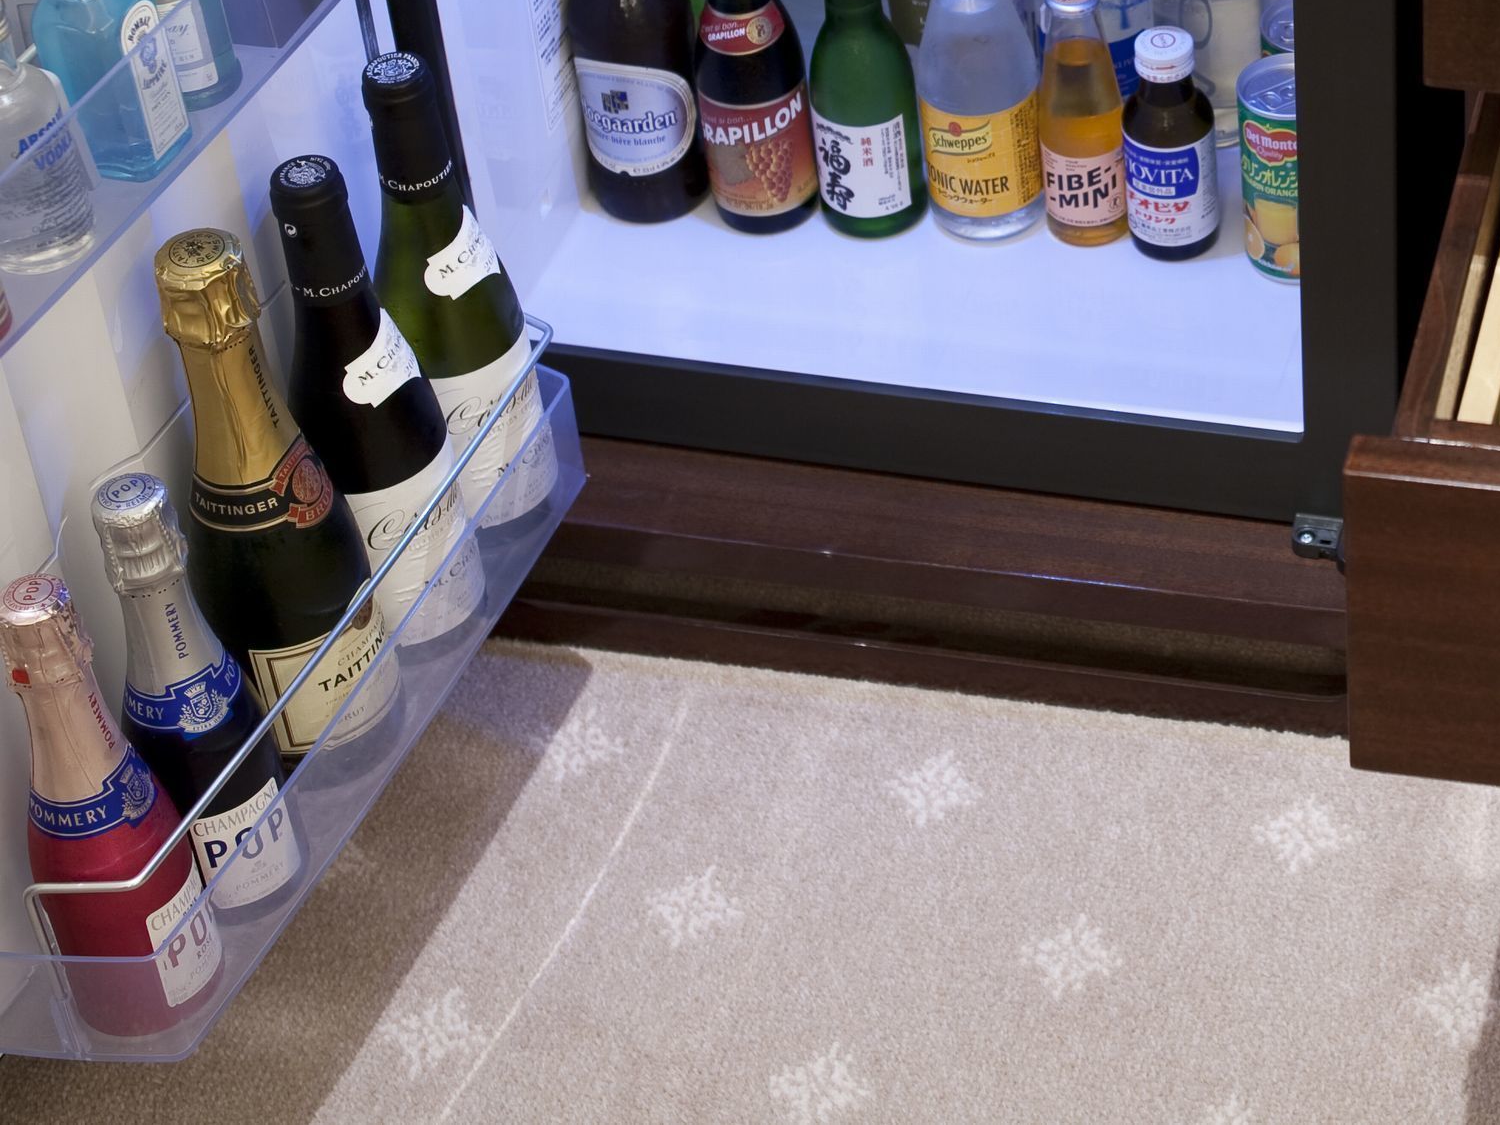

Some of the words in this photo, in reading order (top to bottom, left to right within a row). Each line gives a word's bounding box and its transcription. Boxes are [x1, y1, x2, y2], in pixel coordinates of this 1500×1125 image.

[707, 27, 746, 42] GRAPILLON
[932, 132, 988, 151] Schweppes
[1245, 127, 1260, 146] Del
[1261, 135, 1298, 152] Monte
[959, 175, 1010, 196] WATER
[1046, 165, 1111, 192] FIBE-
[1050, 173, 1117, 209] -MINI
[247, 345, 278, 428] TAITTINGER
[111, 477, 139, 499] POP
[193, 493, 279, 517] TAITTINGER
[305, 486, 334, 521] BRUT
[23, 579, 42, 603] POP
[165, 602, 189, 660] POMMERY
[87, 691, 117, 750] POMMERY
[29, 797, 107, 828] POMMERY
[193, 781, 277, 838] CHAMPAGNE
[204, 807, 284, 869] POP
